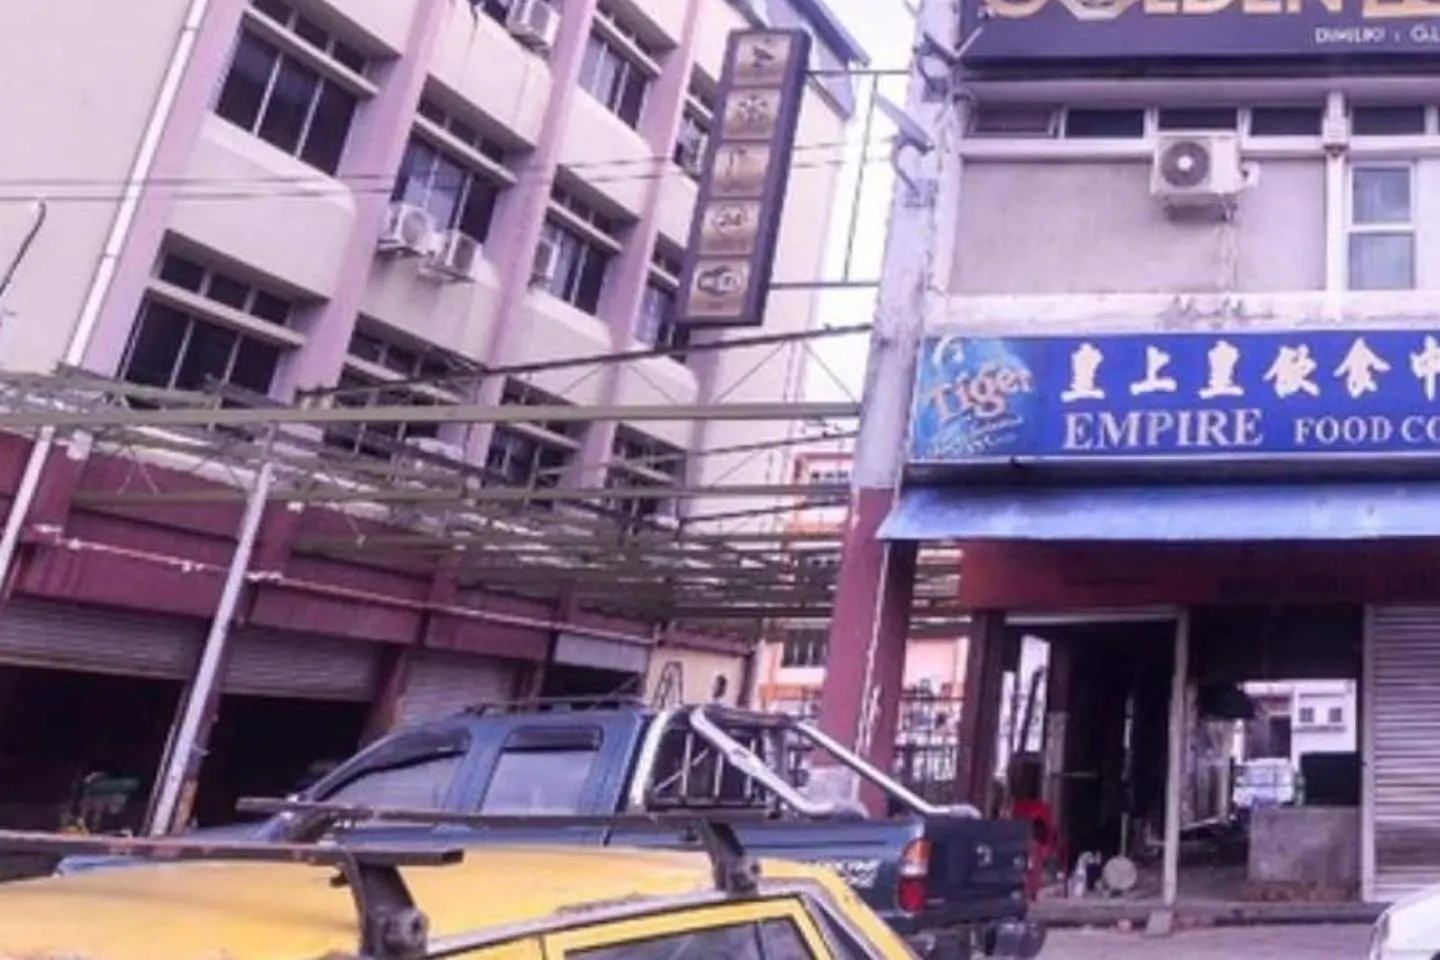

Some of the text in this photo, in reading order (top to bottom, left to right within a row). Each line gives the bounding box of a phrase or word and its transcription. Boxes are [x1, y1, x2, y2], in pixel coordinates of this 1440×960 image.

[928, 360, 1034, 421] Tiger
[1061, 409, 1263, 450] EMPIRE
[1293, 416, 1393, 444] FOOD
